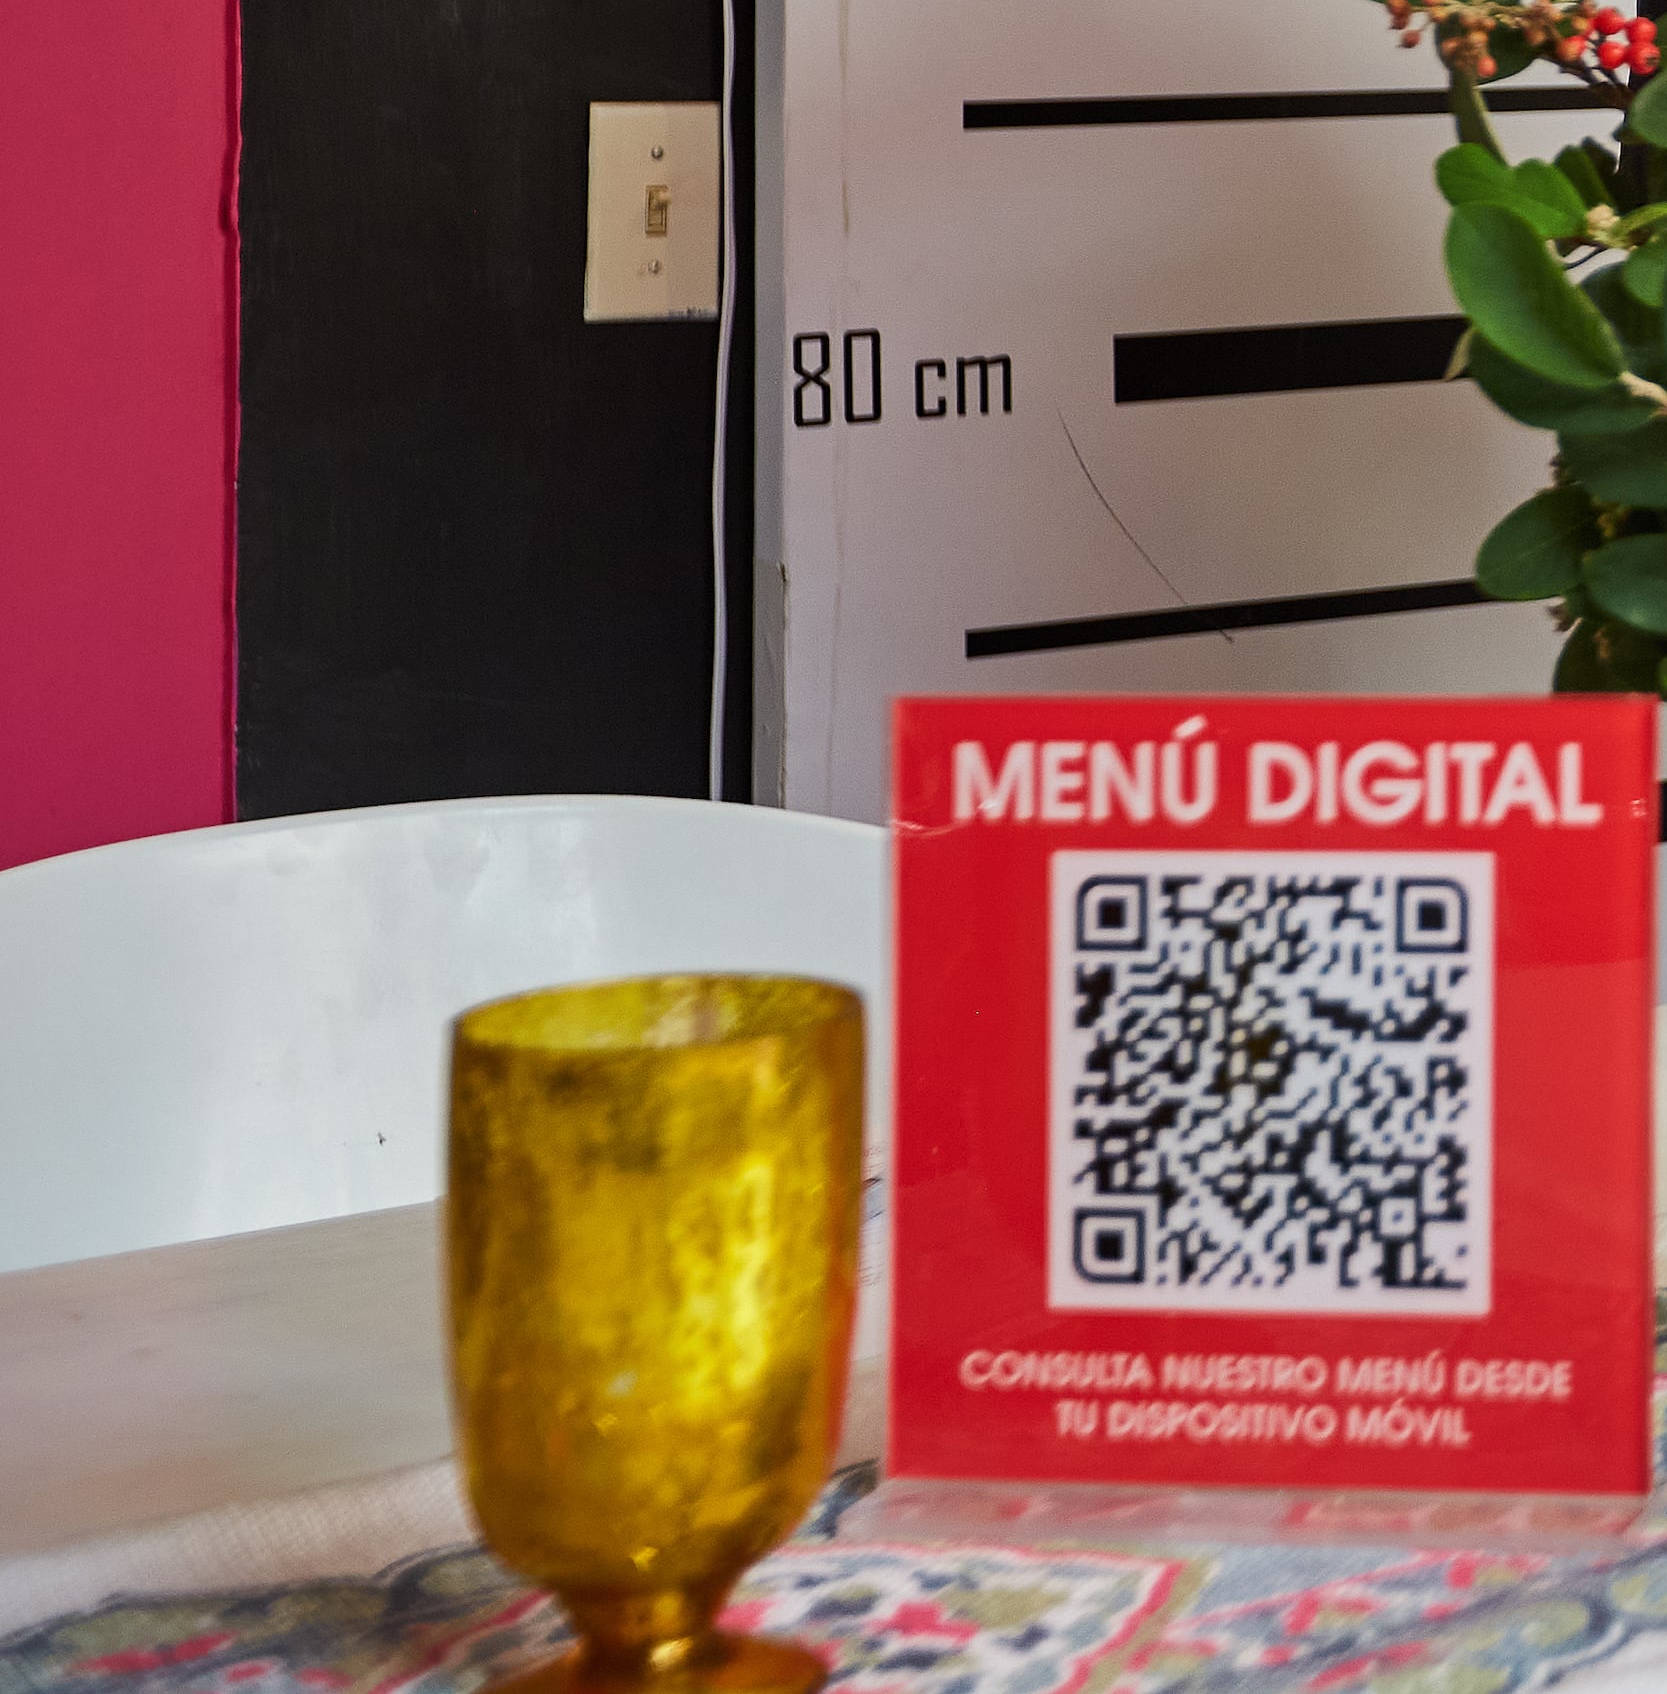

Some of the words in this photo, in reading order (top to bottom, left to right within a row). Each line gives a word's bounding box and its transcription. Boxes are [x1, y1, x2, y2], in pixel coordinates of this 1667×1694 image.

[793, 327, 883, 428] 80
[914, 353, 1013, 419] cm
[952, 716, 1218, 825] MENÚ
[1246, 740, 1604, 828] DIGITAL
[959, 1349, 1155, 1392] CONSULTA
[1160, 1352, 1328, 1396] NUESTRO
[1336, 1348, 1447, 1397] MENÚ
[1455, 1359, 1573, 1402] DESDE
[1055, 1399, 1099, 1439] TU
[1106, 1401, 1338, 1446] DISPOSITIVO
[1346, 1397, 1472, 1448] MÓVIL
